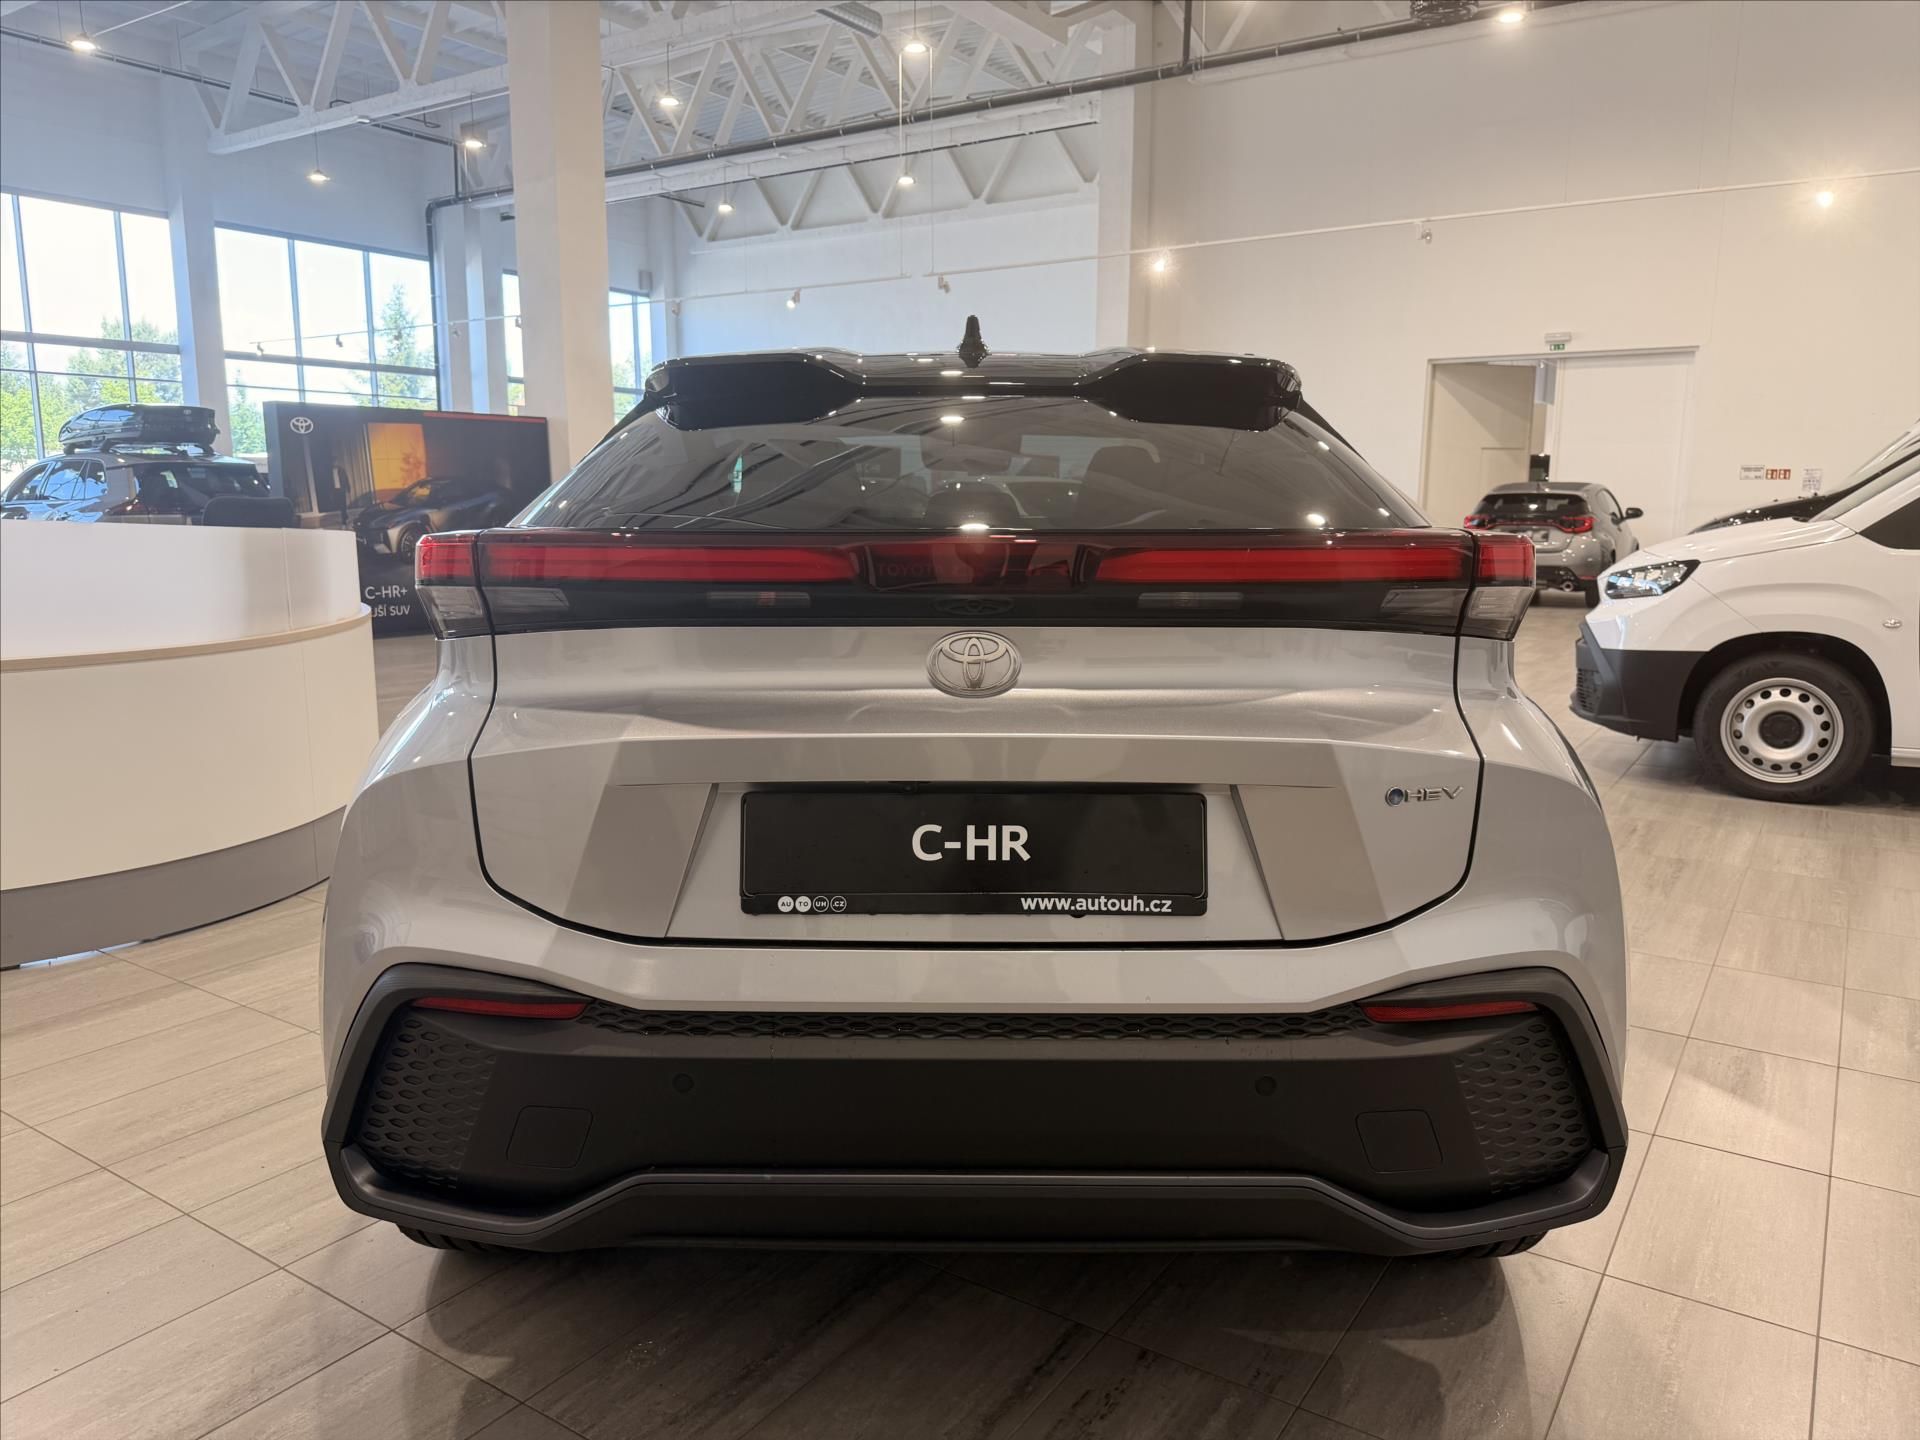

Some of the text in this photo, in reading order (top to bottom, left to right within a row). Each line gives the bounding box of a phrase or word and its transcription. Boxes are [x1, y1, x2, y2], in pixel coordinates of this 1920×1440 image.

[365, 585, 408, 599] C-HR+
[390, 605, 410, 616] SUV
[1404, 786, 1464, 802] HEV
[912, 824, 1031, 861] C-HR
[1020, 895, 1172, 913] www.autouh.cz
